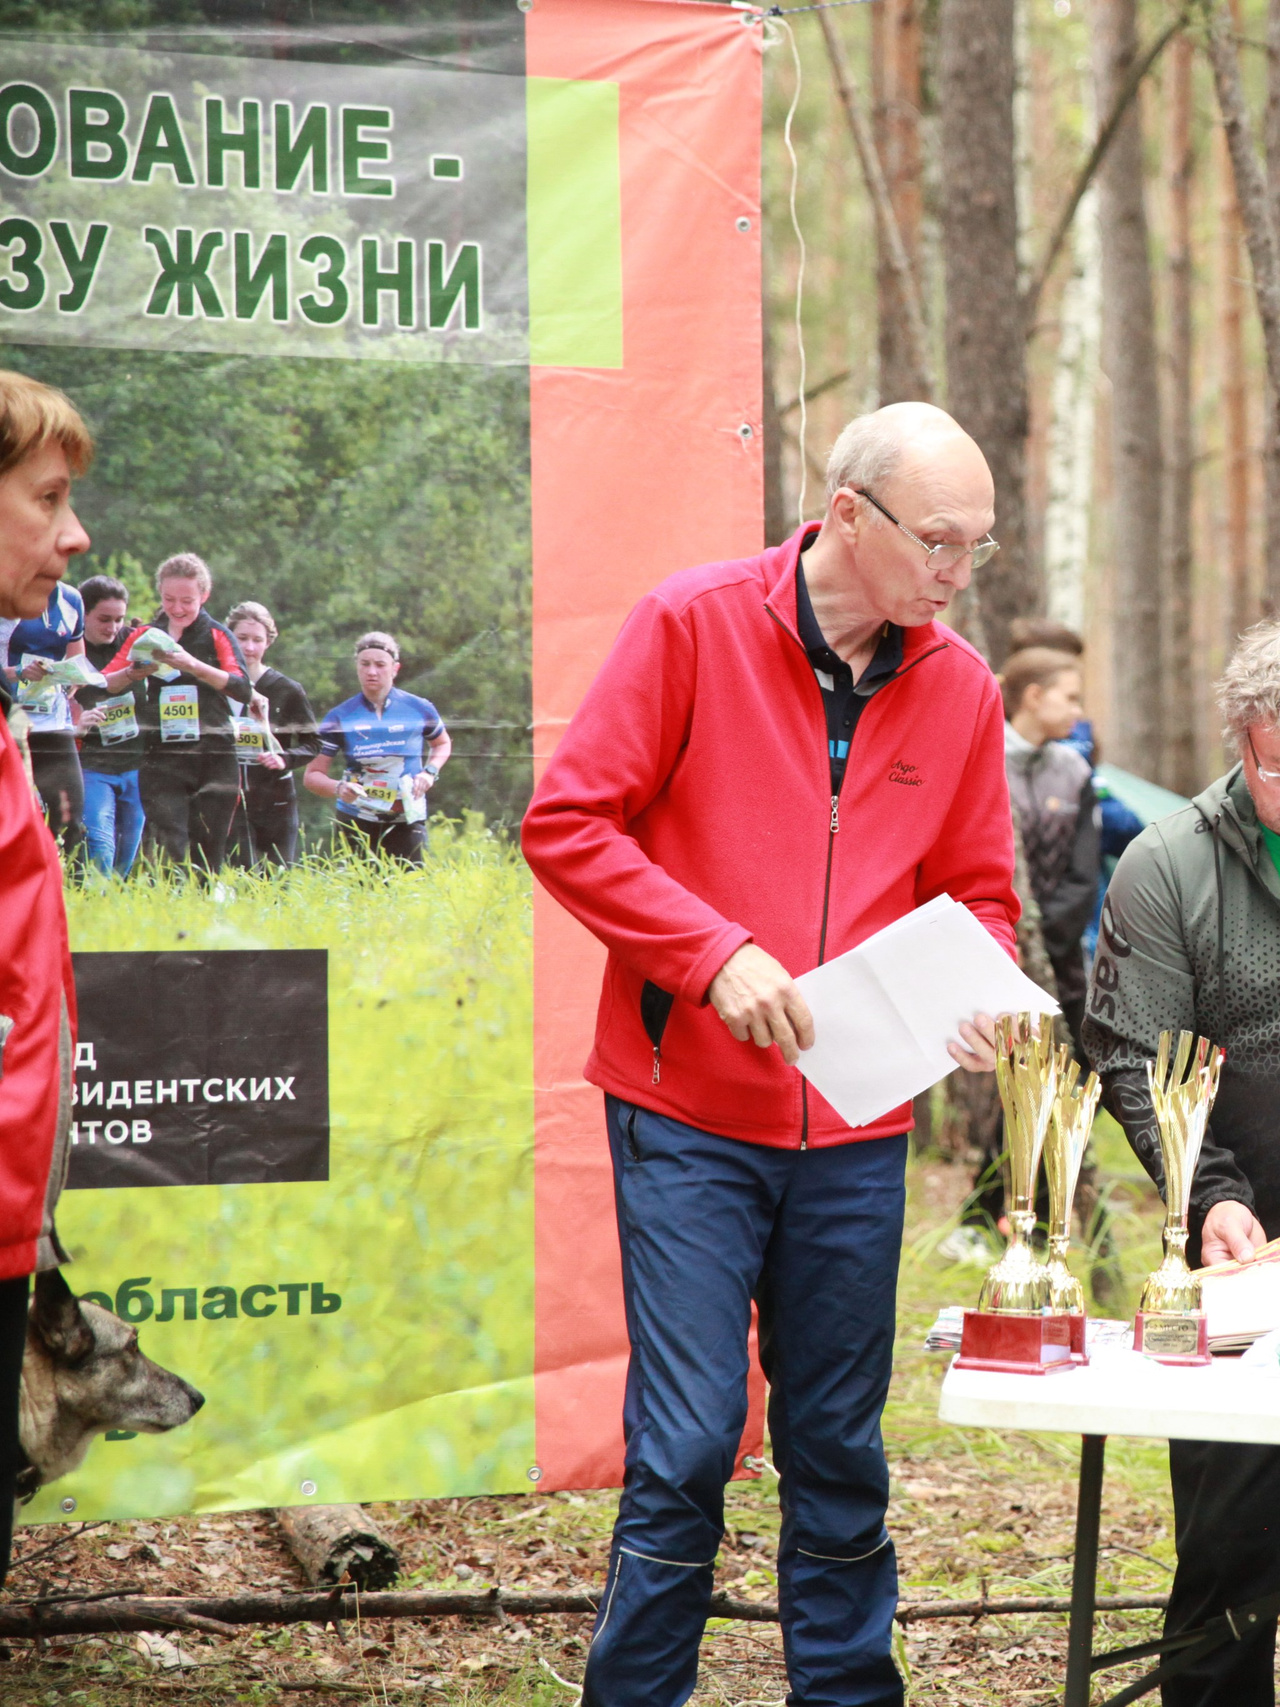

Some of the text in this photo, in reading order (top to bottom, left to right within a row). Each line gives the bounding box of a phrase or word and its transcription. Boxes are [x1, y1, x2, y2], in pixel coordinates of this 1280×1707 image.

[0, 83, 393, 196] ОВАНИЕ
[0, 217, 481, 330] ЗУ ЖИЗНИ
[163, 704, 193, 716] 4501
